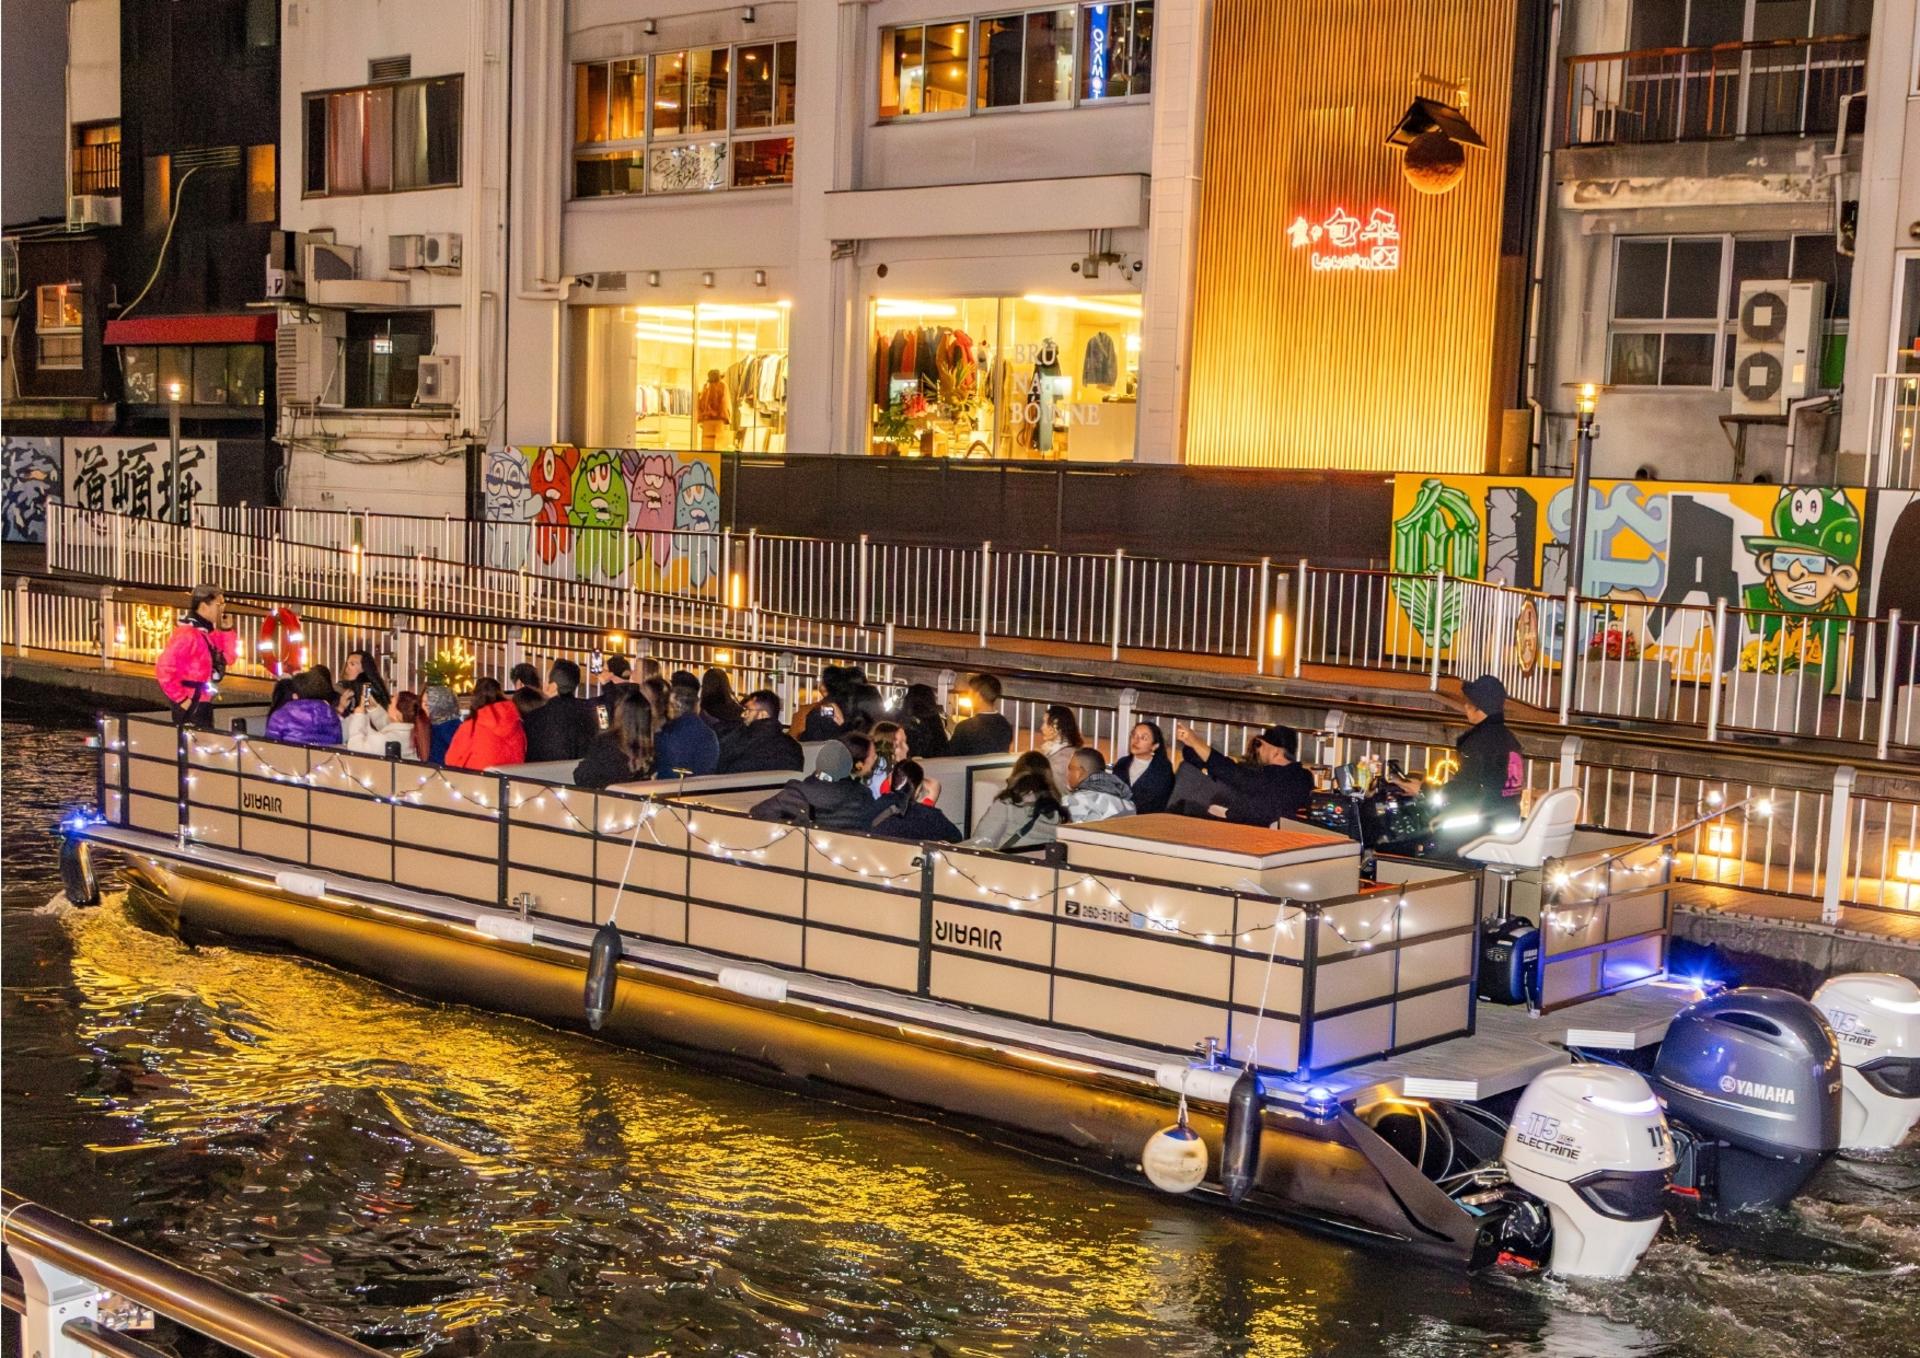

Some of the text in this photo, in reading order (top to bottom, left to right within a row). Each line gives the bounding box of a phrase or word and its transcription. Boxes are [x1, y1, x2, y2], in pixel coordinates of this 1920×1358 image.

[1012, 372, 1042, 395] NA
[1736, 1080, 1795, 1105] YAMAHA
[1526, 1112, 1561, 1142] 115
[1516, 1132, 1581, 1161] ELECTRINE
